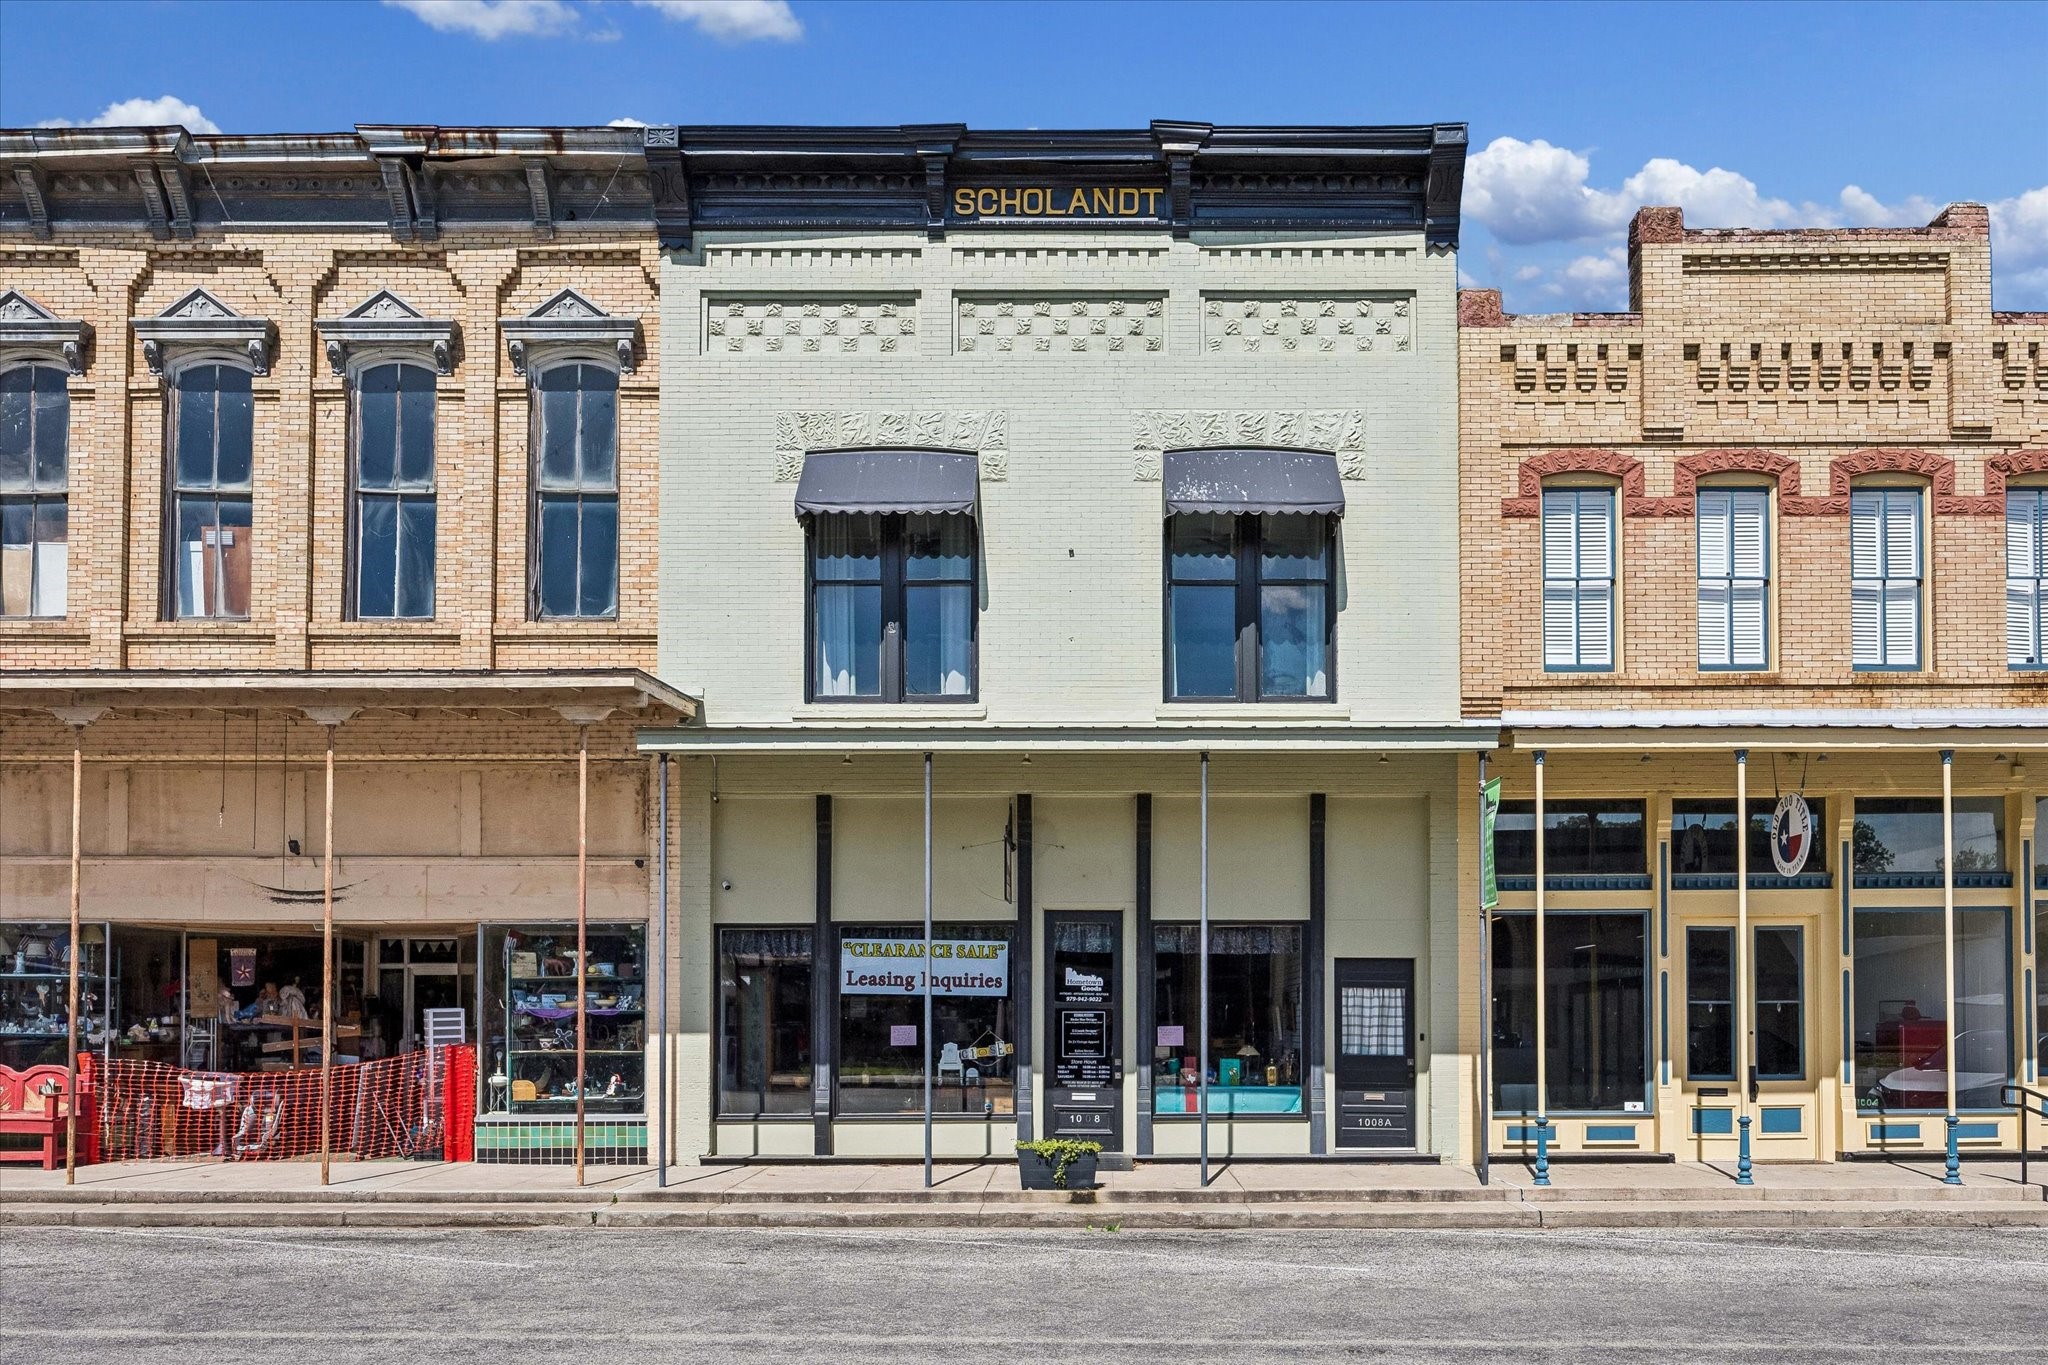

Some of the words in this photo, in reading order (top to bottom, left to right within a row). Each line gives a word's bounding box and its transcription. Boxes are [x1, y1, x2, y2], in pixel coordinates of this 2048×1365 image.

[954, 187, 1164, 215] SCHOLANDT
[1771, 814, 1780, 840] OLD
[1780, 794, 1793, 813] 300
[1795, 797, 1809, 833] TITLE
[846, 970, 916, 992] Leasing
[1358, 1118, 1392, 1127] 1008A
